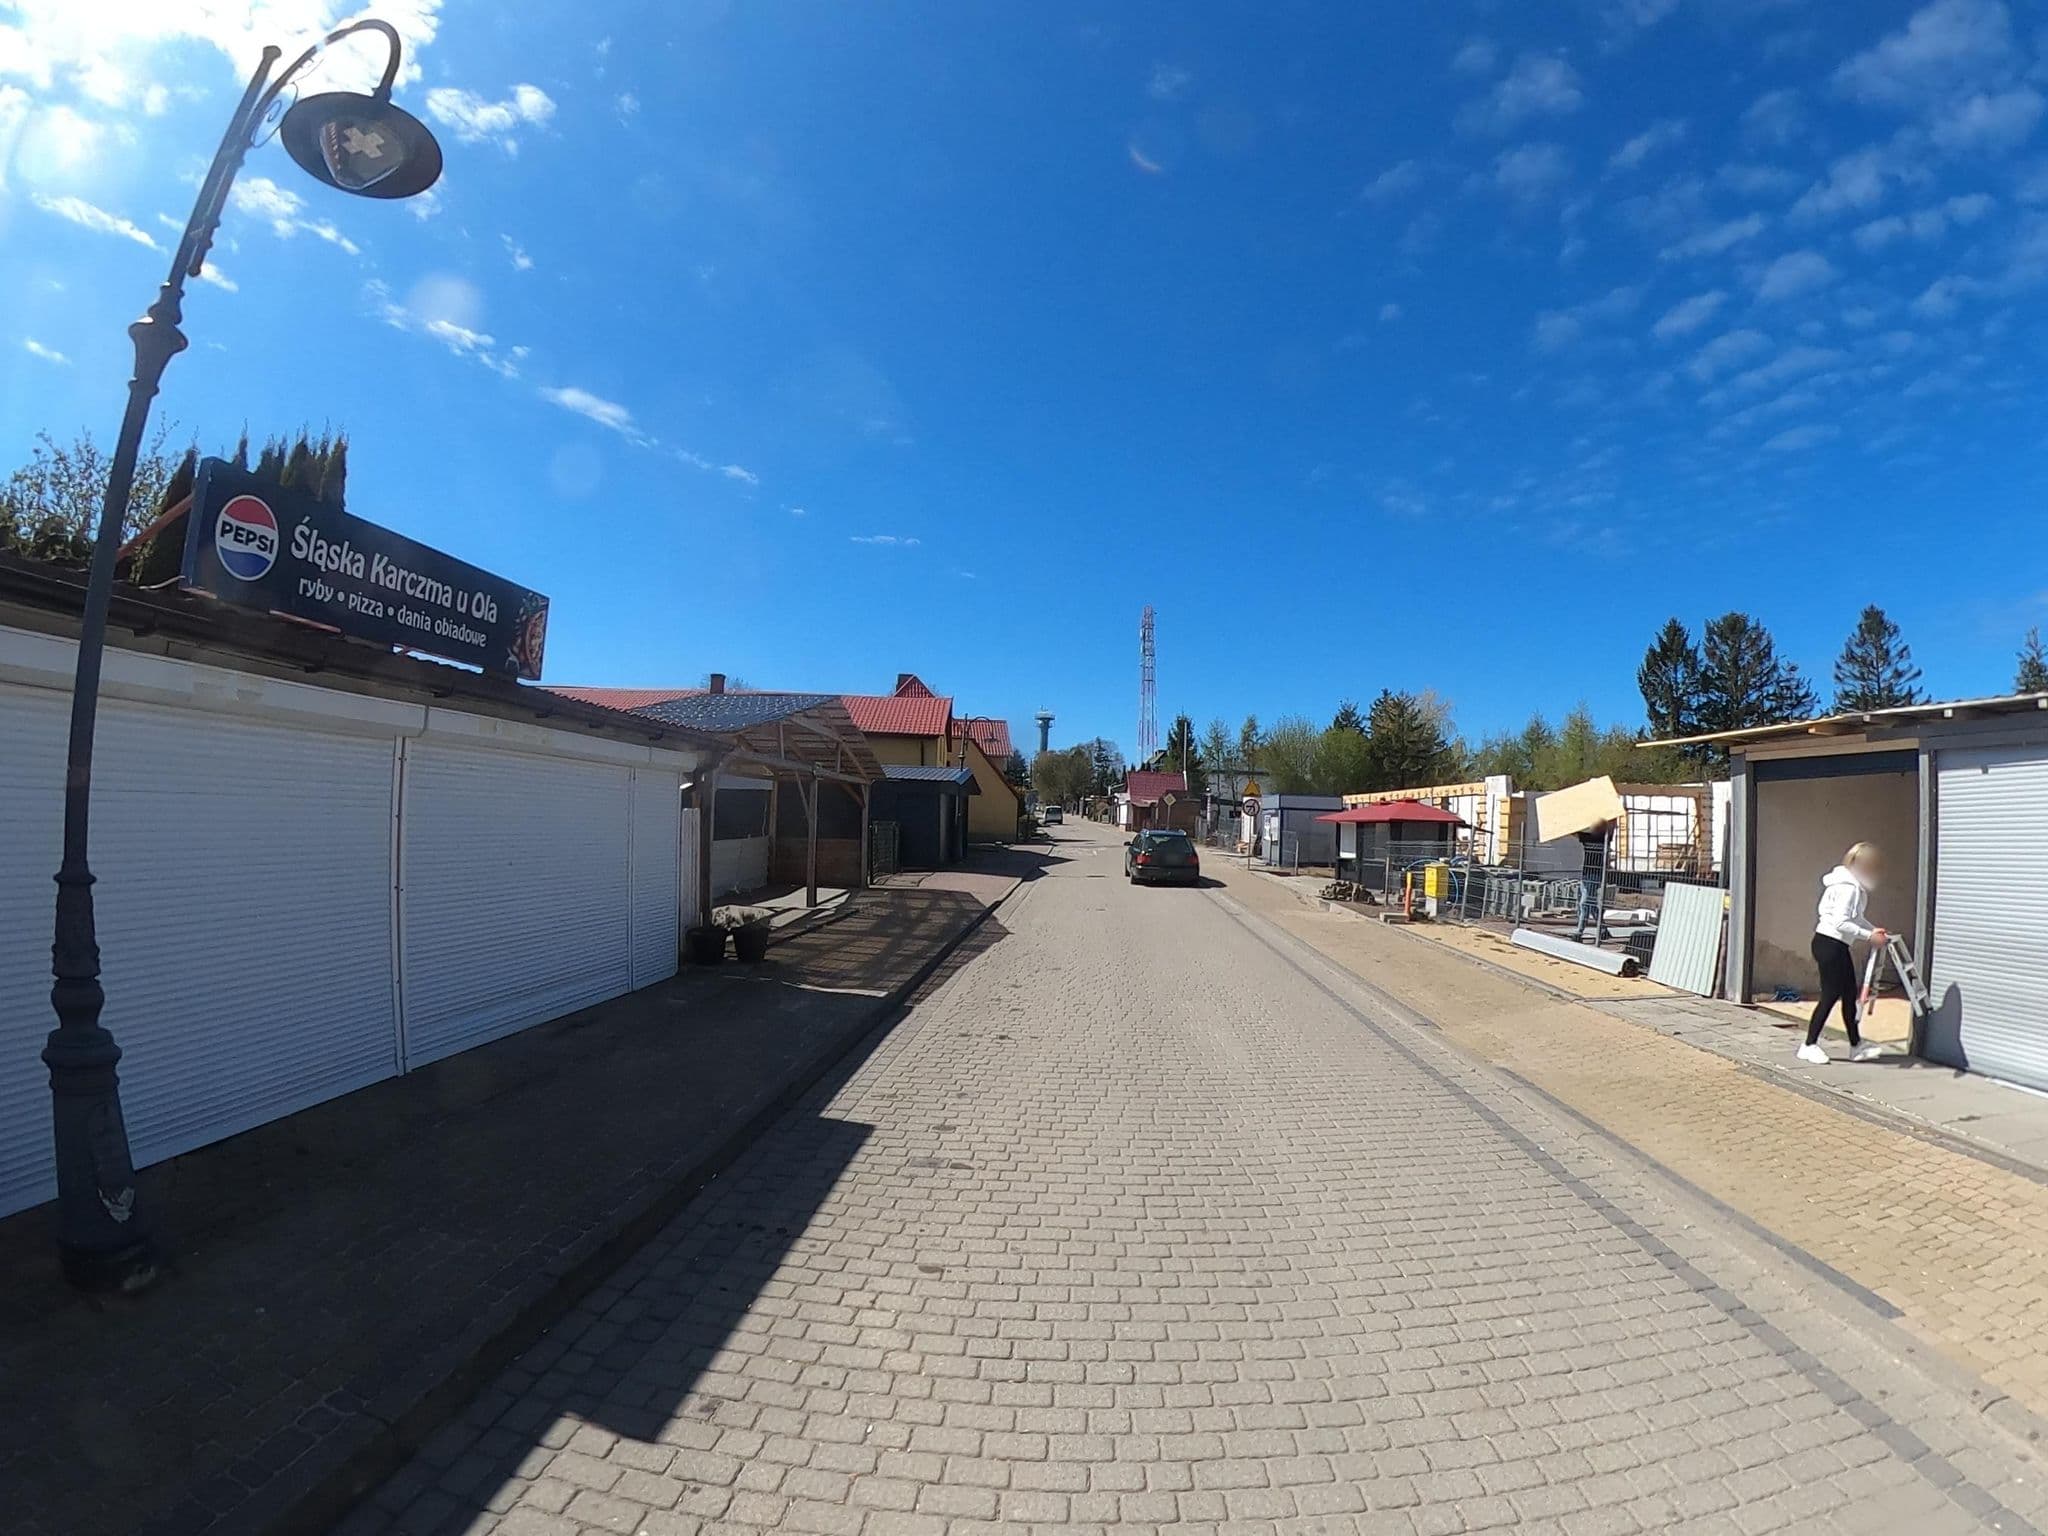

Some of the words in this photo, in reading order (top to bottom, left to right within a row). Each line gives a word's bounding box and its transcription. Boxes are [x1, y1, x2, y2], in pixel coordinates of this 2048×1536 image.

[220, 520, 275, 554] PEPSI
[291, 516, 365, 579] Śląska
[370, 553, 453, 608] Karczma
[456, 590, 468, 613] u
[471, 592, 498, 623] Ola
[299, 578, 334, 603] ryby
[349, 591, 383, 618] pizza
[397, 605, 431, 631] dania
[434, 618, 487, 647] obiadowe
